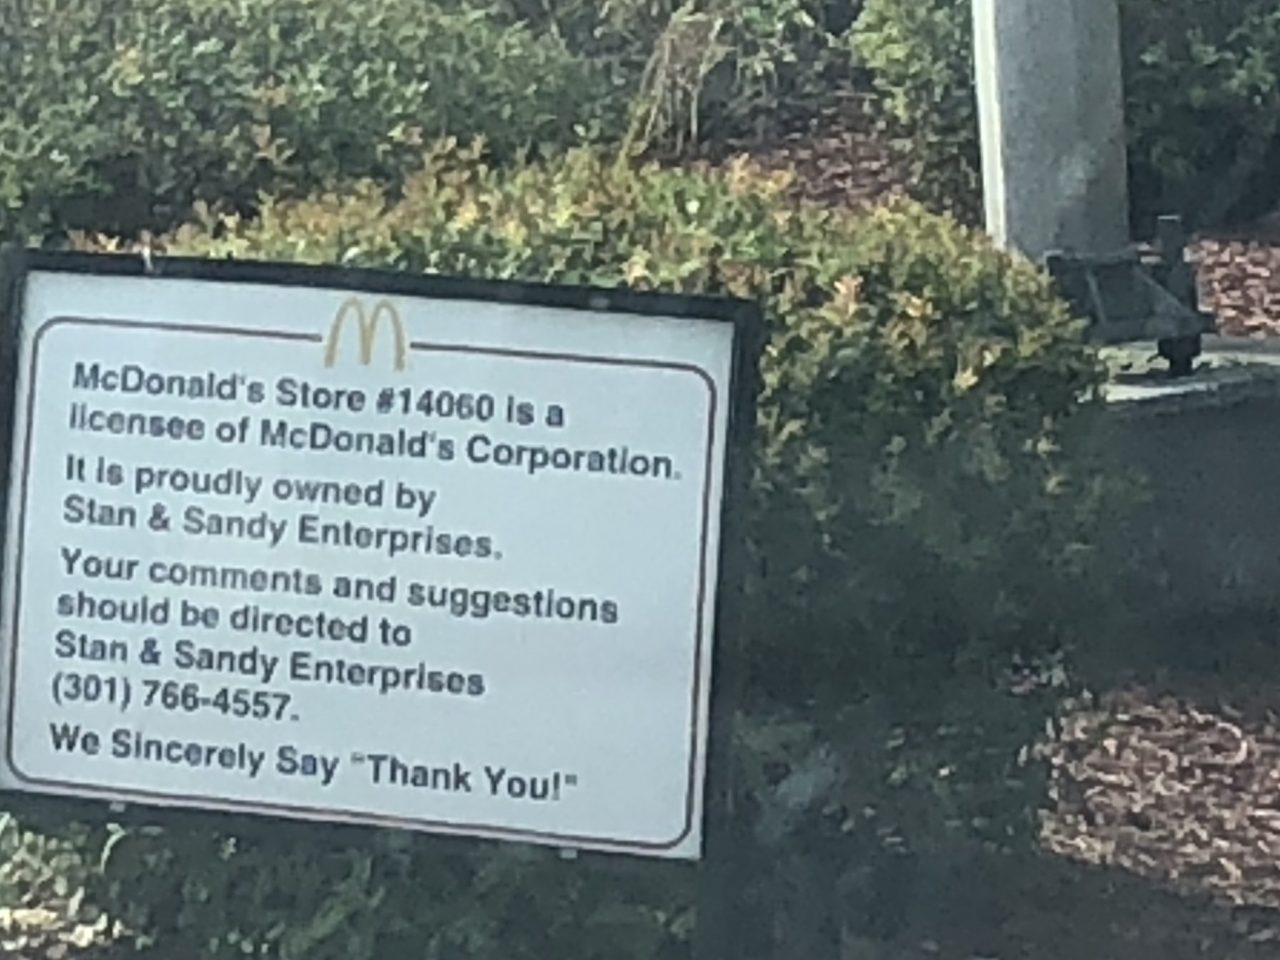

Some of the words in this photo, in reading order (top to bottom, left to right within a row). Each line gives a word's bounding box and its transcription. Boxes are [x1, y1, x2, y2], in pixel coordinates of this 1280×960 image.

[73, 362, 265, 403] McDonald's
[276, 378, 366, 412] Store
[376, 388, 494, 422] #14060
[506, 395, 534, 425] is
[545, 405, 564, 428] a
[70, 403, 205, 440] licensee
[216, 416, 250, 443] of
[260, 419, 454, 460] McDonald's
[466, 434, 681, 480] Corporation.
[66, 454, 85, 482] It
[96, 456, 124, 486] is
[135, 467, 262, 503] proudly
[273, 479, 384, 507] owned
[396, 482, 436, 518] by
[64, 494, 136, 528] Stan
[148, 503, 170, 531] &
[183, 506, 287, 548] Sandy
[299, 514, 502, 560] Enterprises.
[61, 547, 139, 580] Your
[149, 562, 322, 595] comments
[333, 576, 396, 603] and
[407, 583, 618, 624] suggestions
[57, 591, 170, 625] should
[181, 600, 219, 629] be
[230, 605, 368, 643] directed
[379, 618, 411, 647] to
[55, 629, 127, 663] Stan
[139, 638, 161, 666] &
[174, 640, 279, 683] Sandy
[290, 651, 485, 696] Enterprises
[52, 672, 131, 712] (301)
[142, 680, 299, 721] 766-4557.
[49, 723, 100, 755] We
[112, 729, 265, 778] Sincerely
[276, 745, 339, 786] Say
